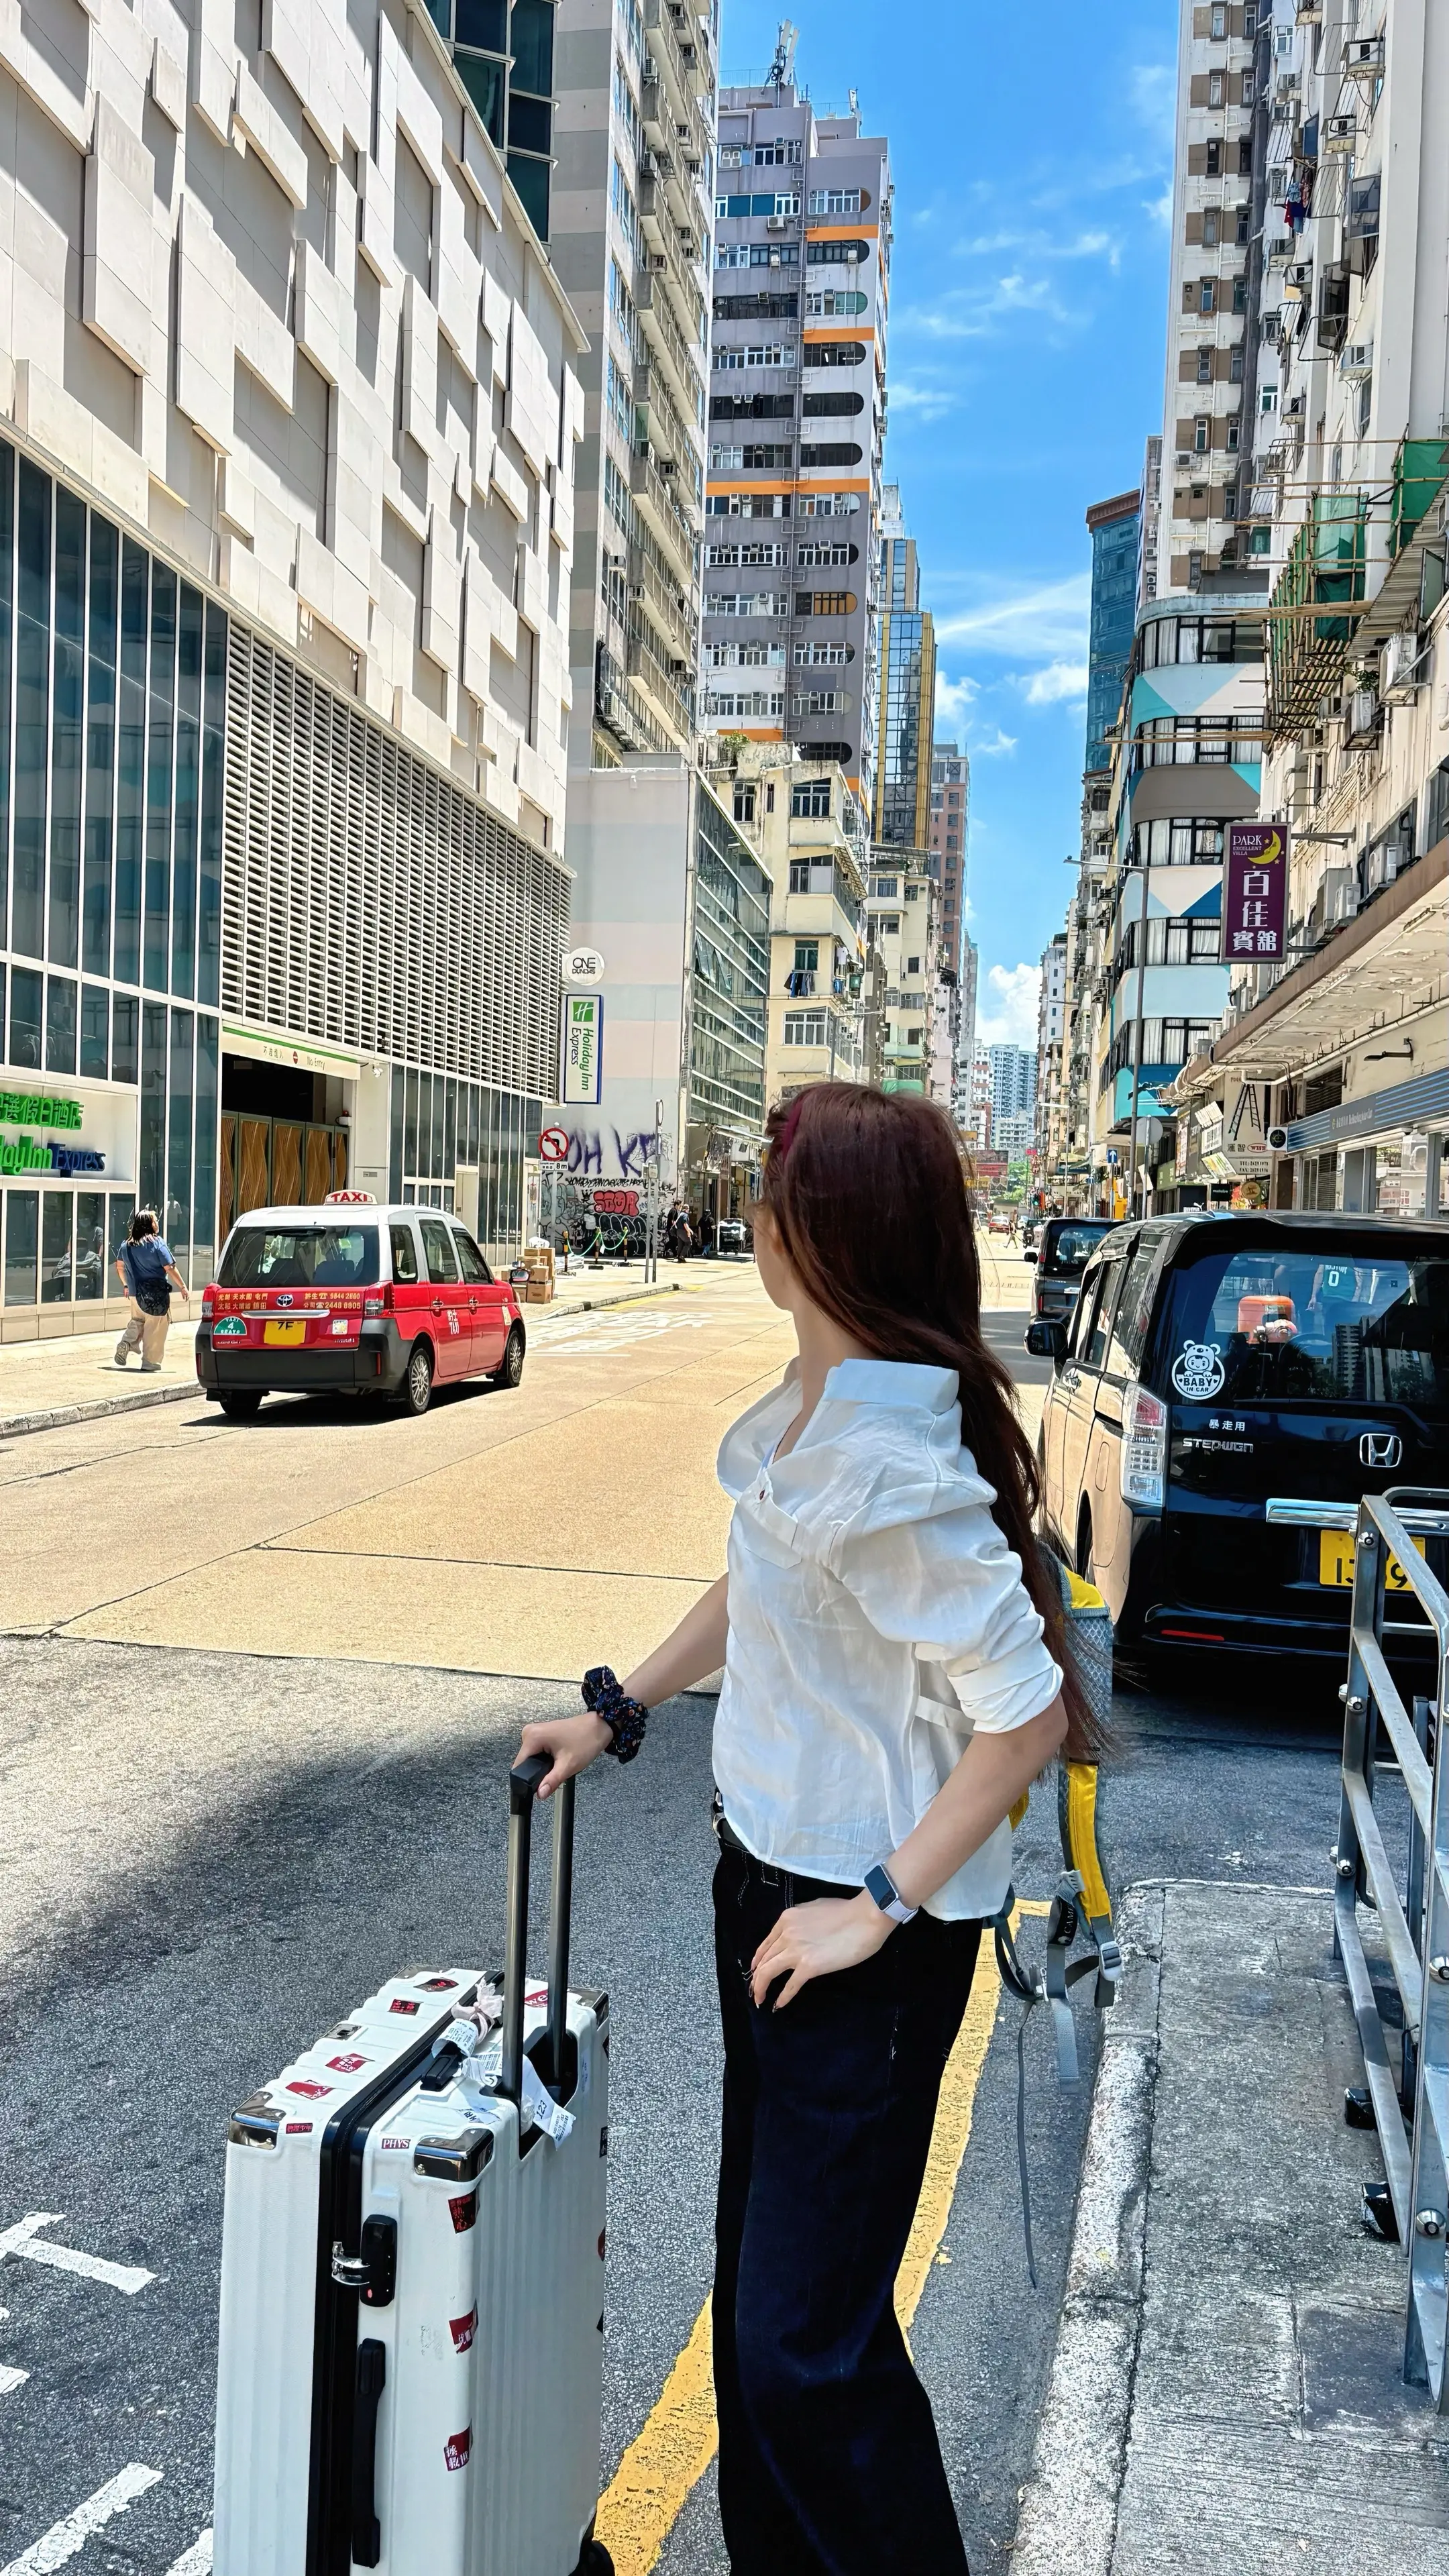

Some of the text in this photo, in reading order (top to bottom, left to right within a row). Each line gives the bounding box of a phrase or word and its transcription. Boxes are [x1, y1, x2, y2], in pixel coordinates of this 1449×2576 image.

[1232, 835, 1262, 845] PARK
[1242, 870, 1270, 927] 百佳
[573, 957, 596, 969] ONE
[570, 1028, 582, 1065] Express
[580, 1028, 594, 1090] Holiday Inn
[0, 1093, 84, 1130] 選假日酒店
[48, 1143, 106, 1178] Express
[331, 1192, 368, 1203] TAXI
[449, 1322, 460, 1334] TAXI
[1183, 1378, 1212, 1386] BABY
[1209, 1419, 1246, 1432] 暴走用
[537, 2100, 547, 2120] 123
[383, 2139, 409, 2149] PHYS
